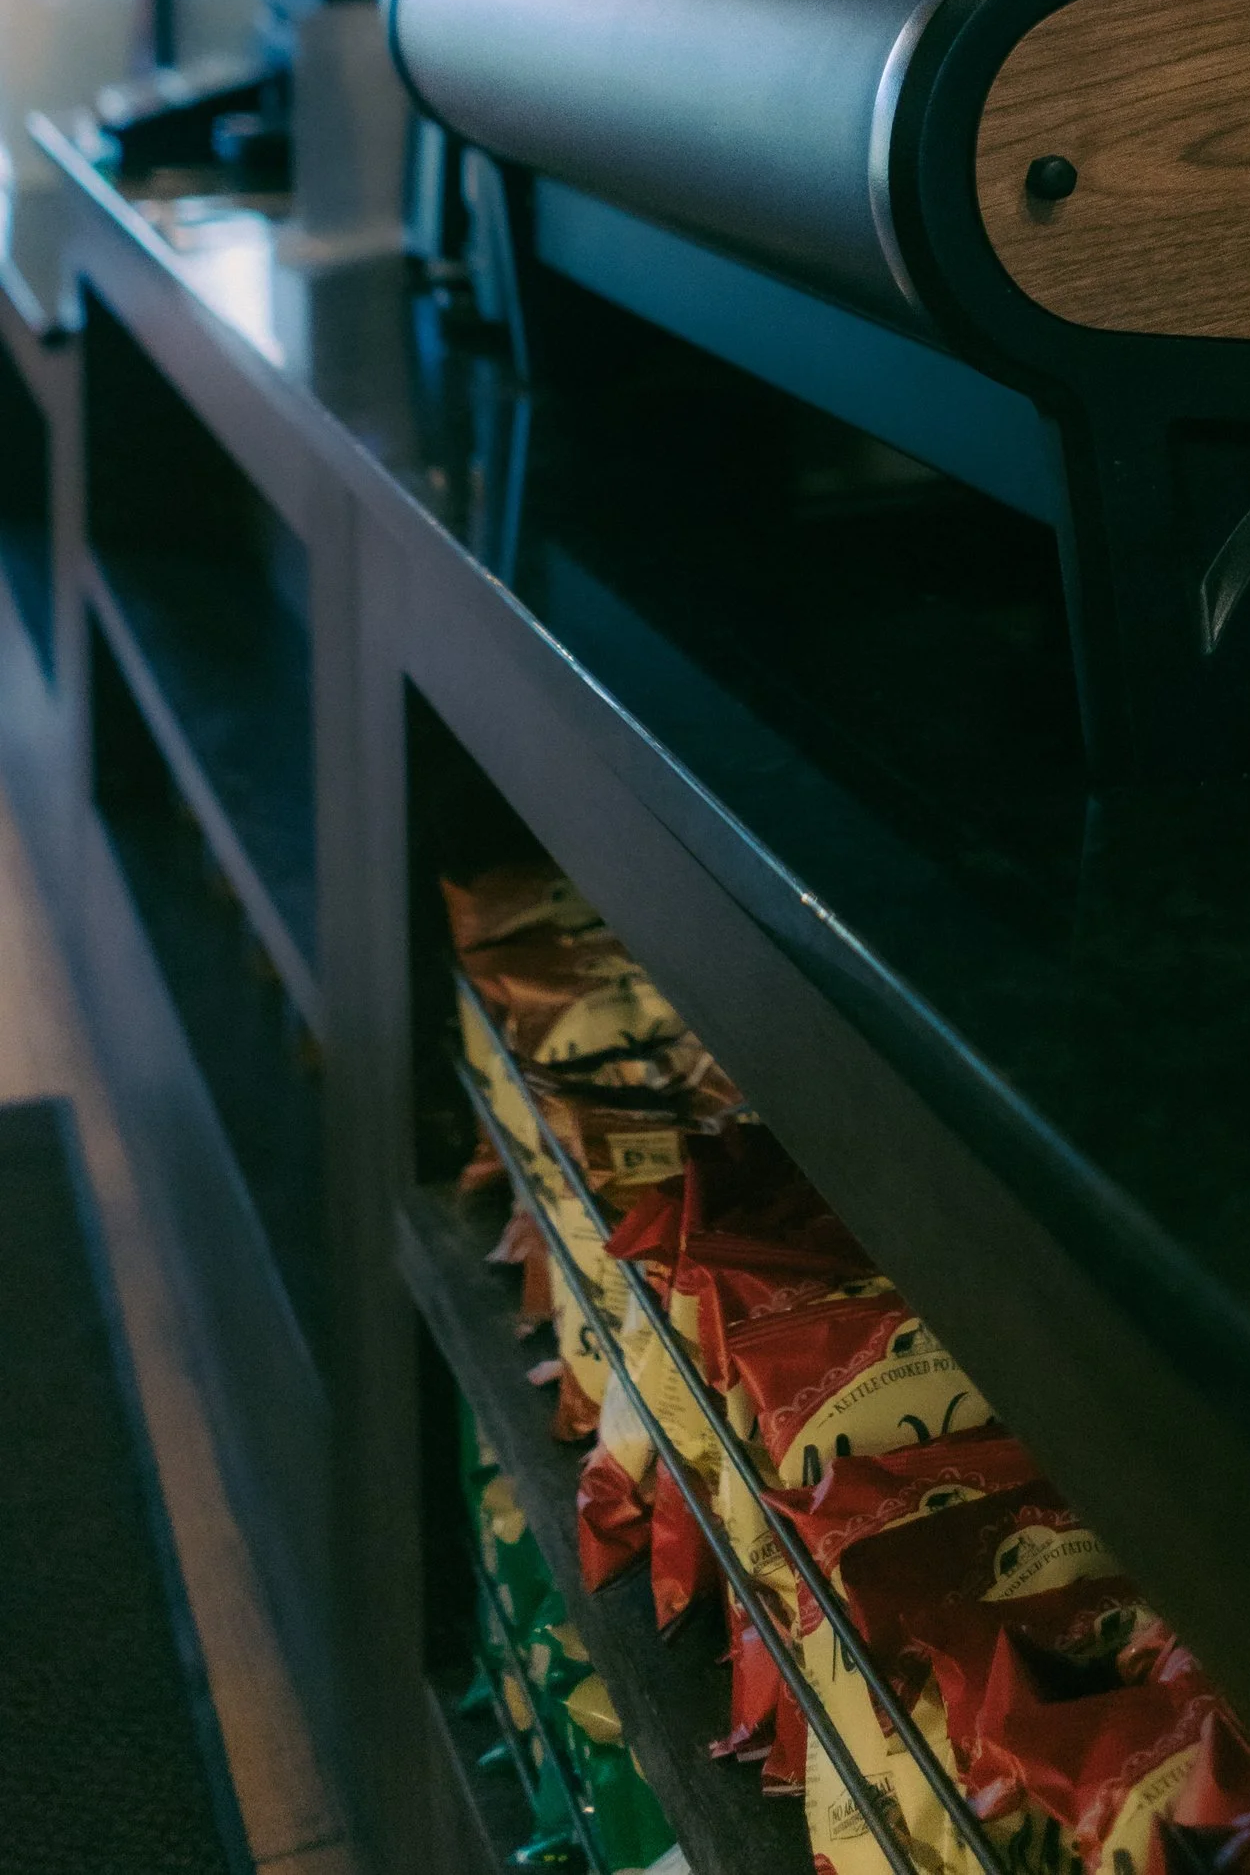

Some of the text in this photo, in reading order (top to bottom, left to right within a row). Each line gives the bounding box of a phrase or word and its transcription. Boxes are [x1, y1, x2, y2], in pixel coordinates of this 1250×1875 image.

[834, 1376, 882, 1414] KETTLE
[880, 1359, 931, 1387] COOKED
[1043, 1540, 1092, 1564] POTATO
